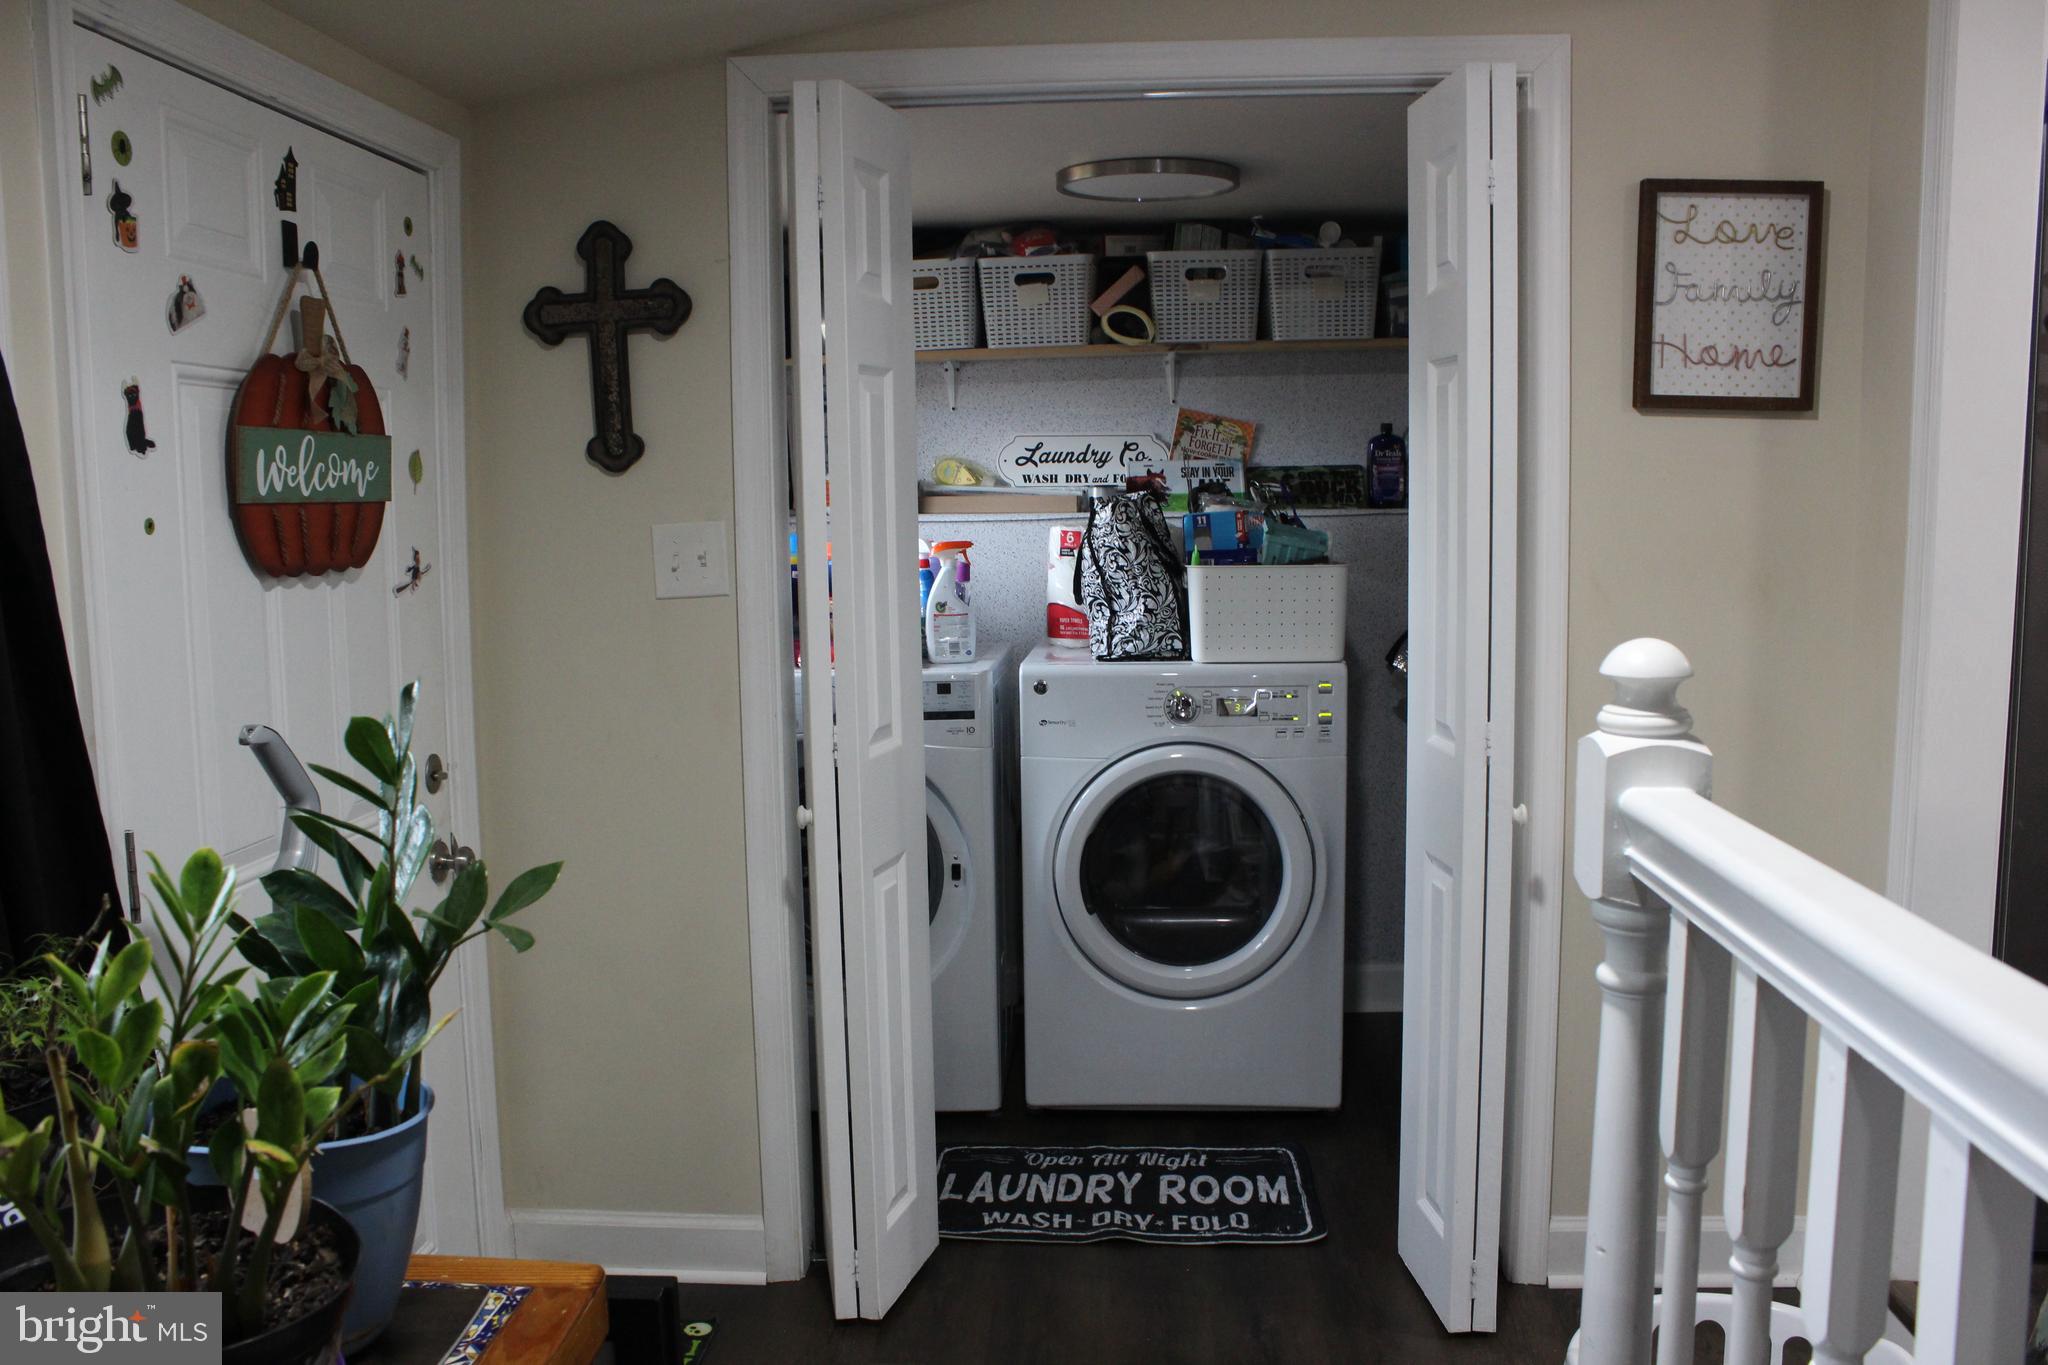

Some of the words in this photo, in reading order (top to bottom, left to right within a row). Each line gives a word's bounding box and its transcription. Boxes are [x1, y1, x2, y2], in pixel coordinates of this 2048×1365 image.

[1657, 203, 1795, 250] Love
[1656, 261, 1802, 326] Family
[1652, 333, 1797, 371] Home
[1015, 441, 1113, 469] Laundry
[1189, 436, 1234, 457] FORGET-IT
[256, 434, 380, 497] Welcome
[1181, 466, 1200, 478] STAY
[1201, 466, 1211, 478] IN
[1212, 466, 1235, 478] YOUR
[1022, 474, 1058, 484] WASH
[1065, 474, 1090, 484] DRY
[1092, 474, 1109, 484] and
[1066, 532, 1075, 543] 6
[1024, 1151, 1084, 1168] Open
[1093, 1152, 1128, 1167] All
[1138, 1151, 1208, 1171] Night
[939, 1171, 1143, 1205] LAUNDRY
[1159, 1174, 1291, 1206] ROOM
[982, 1210, 1073, 1230] WASH
[1091, 1210, 1156, 1232] DRY
